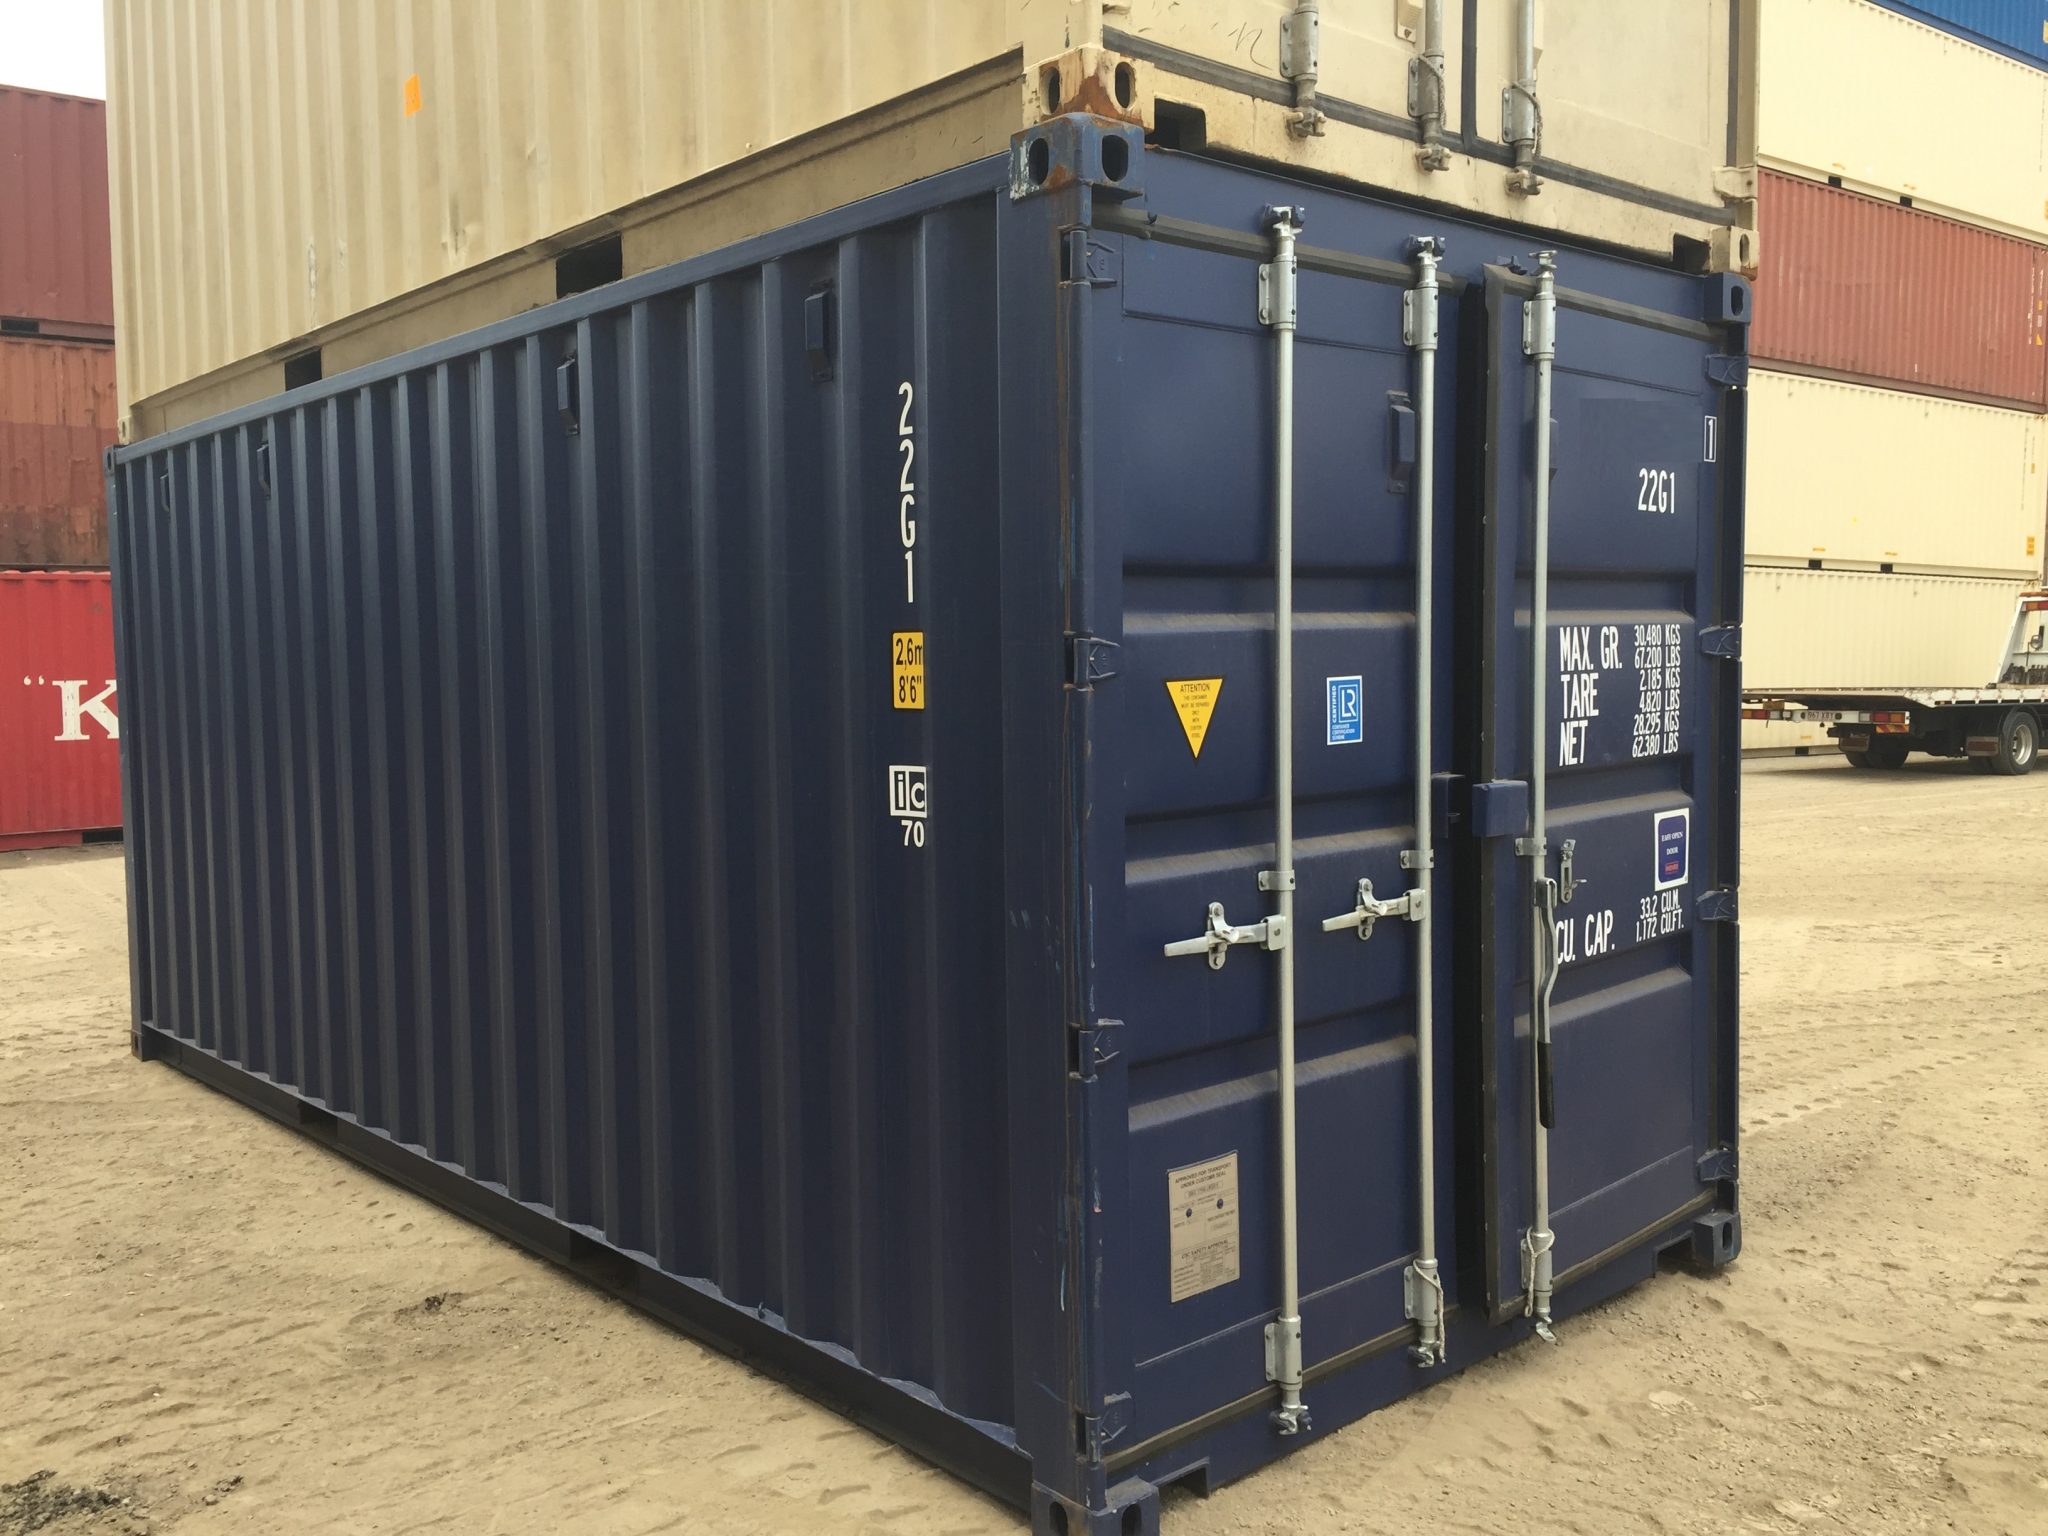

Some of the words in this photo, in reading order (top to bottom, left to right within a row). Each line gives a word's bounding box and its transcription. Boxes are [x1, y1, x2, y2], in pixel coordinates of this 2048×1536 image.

[898, 381, 915, 603] 22G1
[1638, 468, 1675, 514] 22G1
[1560, 626, 1594, 671] MAX.
[1600, 626, 1622, 669] GR.
[1634, 624, 1662, 647] 30.480
[1665, 624, 1680, 646] KGS
[1634, 646, 1662, 668] 67.200
[1665, 646, 1680, 667] LBS
[899, 675, 922, 703] 8'6"
[1180, 683, 1211, 693] ATTENTION
[1640, 668, 1662, 691] 2.185
[1665, 668, 1680, 689] KGS
[1561, 672, 1599, 719] TARE
[1639, 690, 1662, 712] 4.820
[1665, 689, 1680, 710] LBS
[1633, 712, 1661, 736] 28.295
[1664, 711, 1680, 733] KGS
[1559, 720, 1588, 767] NET
[1632, 735, 1660, 758] 62.380
[1663, 732, 1679, 754] LBS
[901, 820, 925, 847] 70
[1672, 831, 1683, 840] OPEN
[1666, 847, 1678, 855] DOOR
[1640, 895, 1657, 920] 33.2
[1556, 918, 1576, 965] CU.
[1585, 909, 1615, 957] CAP.
[1636, 917, 1657, 943] 1.172
